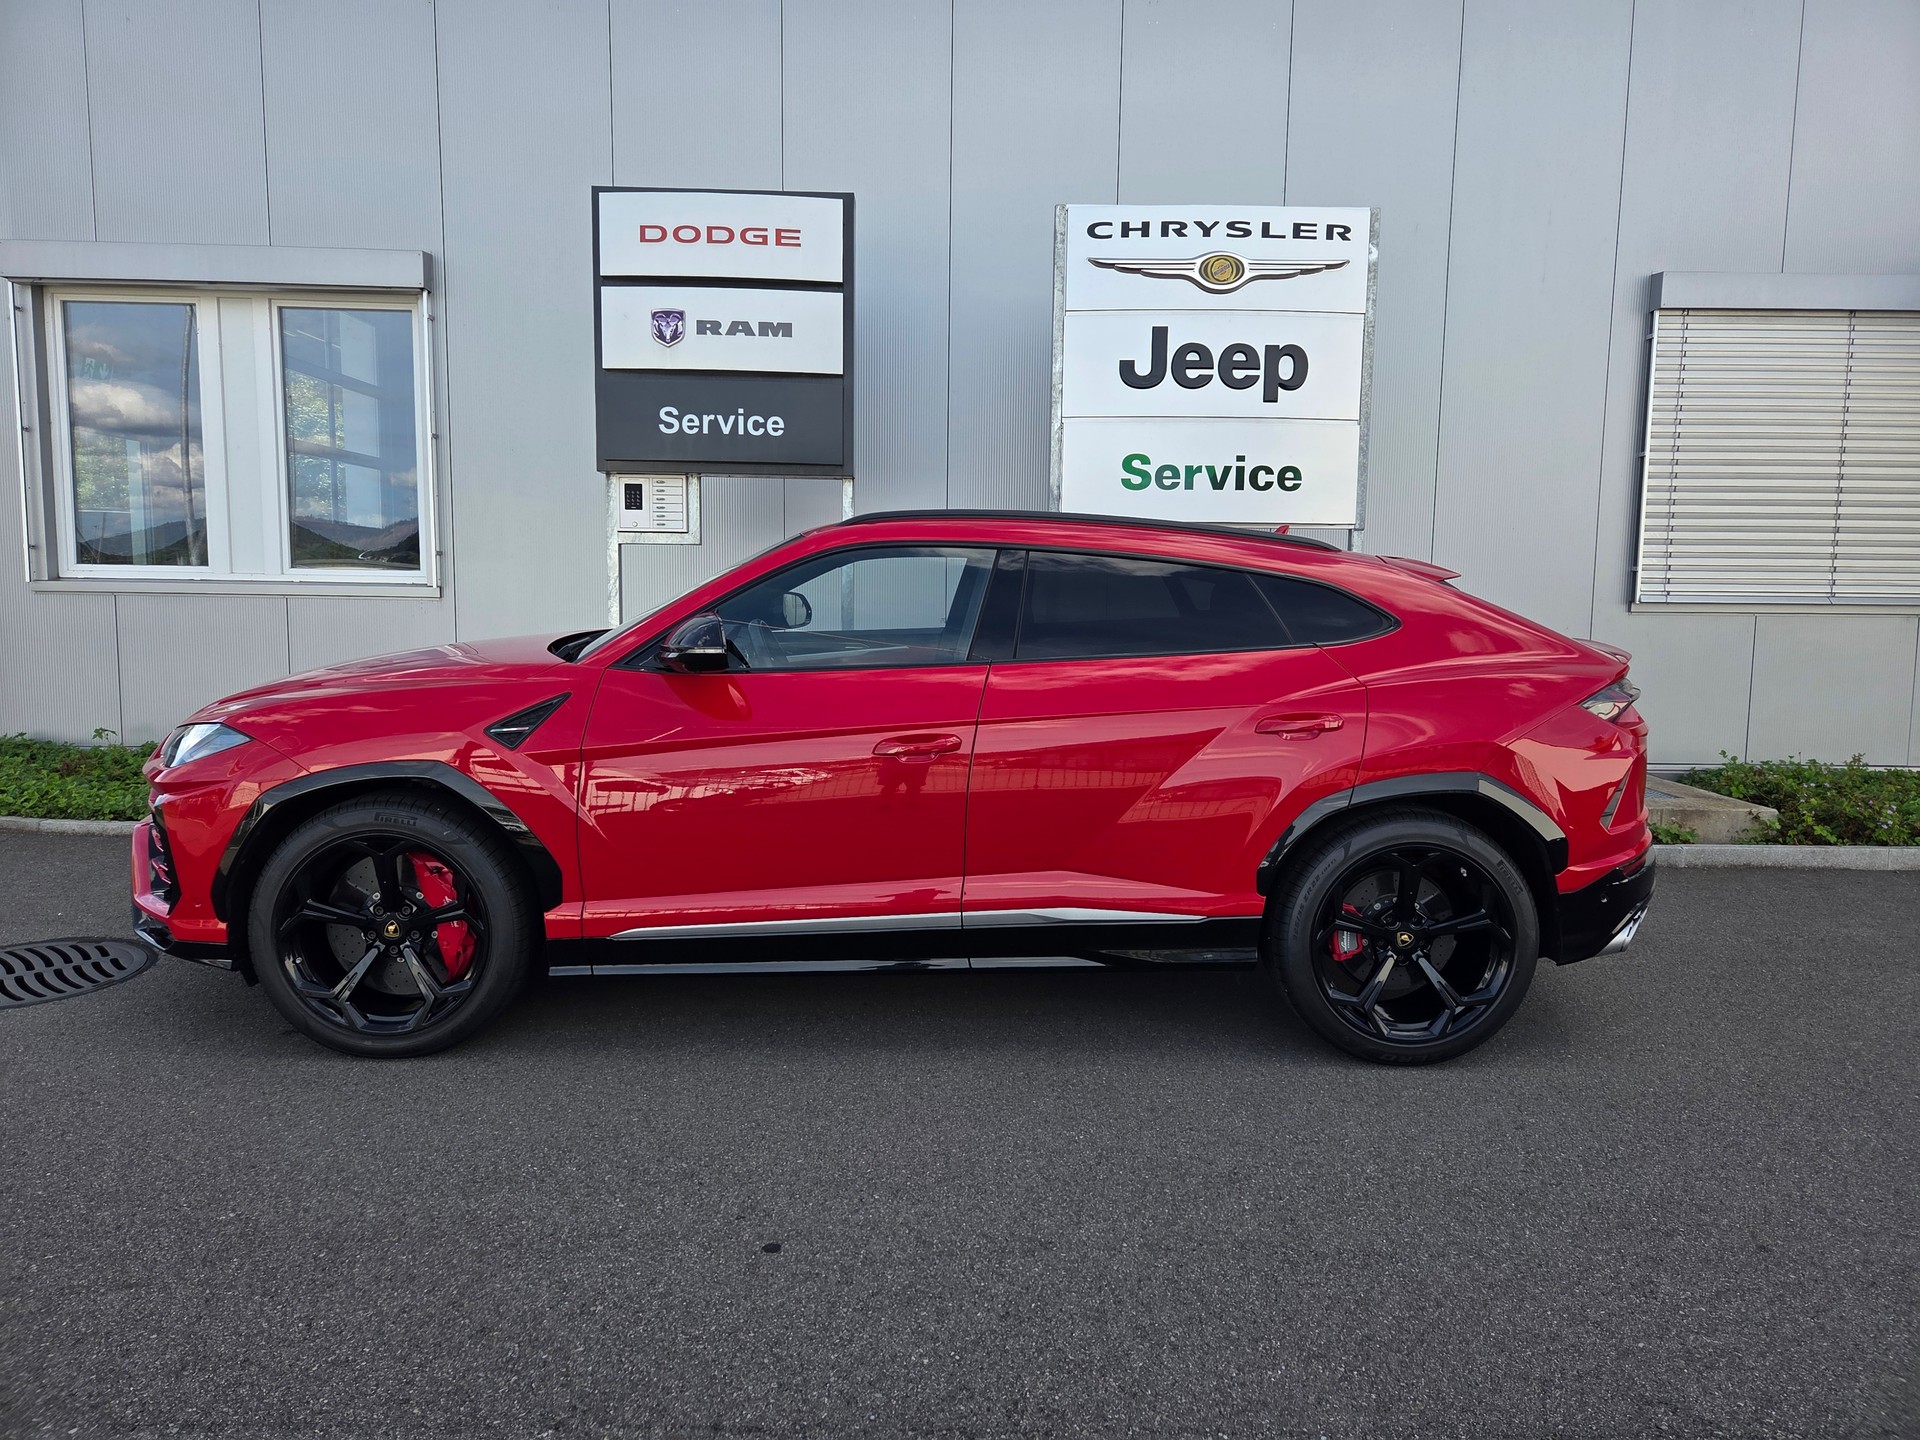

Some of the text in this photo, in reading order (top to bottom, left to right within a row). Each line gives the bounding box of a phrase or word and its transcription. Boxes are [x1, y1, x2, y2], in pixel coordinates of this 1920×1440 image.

[639, 225, 802, 247] DODGE
[1086, 220, 1352, 241] CHRYSLER
[696, 319, 793, 338] RAM
[1118, 326, 1309, 403] Jeep
[658, 406, 785, 437] Service
[1120, 453, 1302, 492] Service
